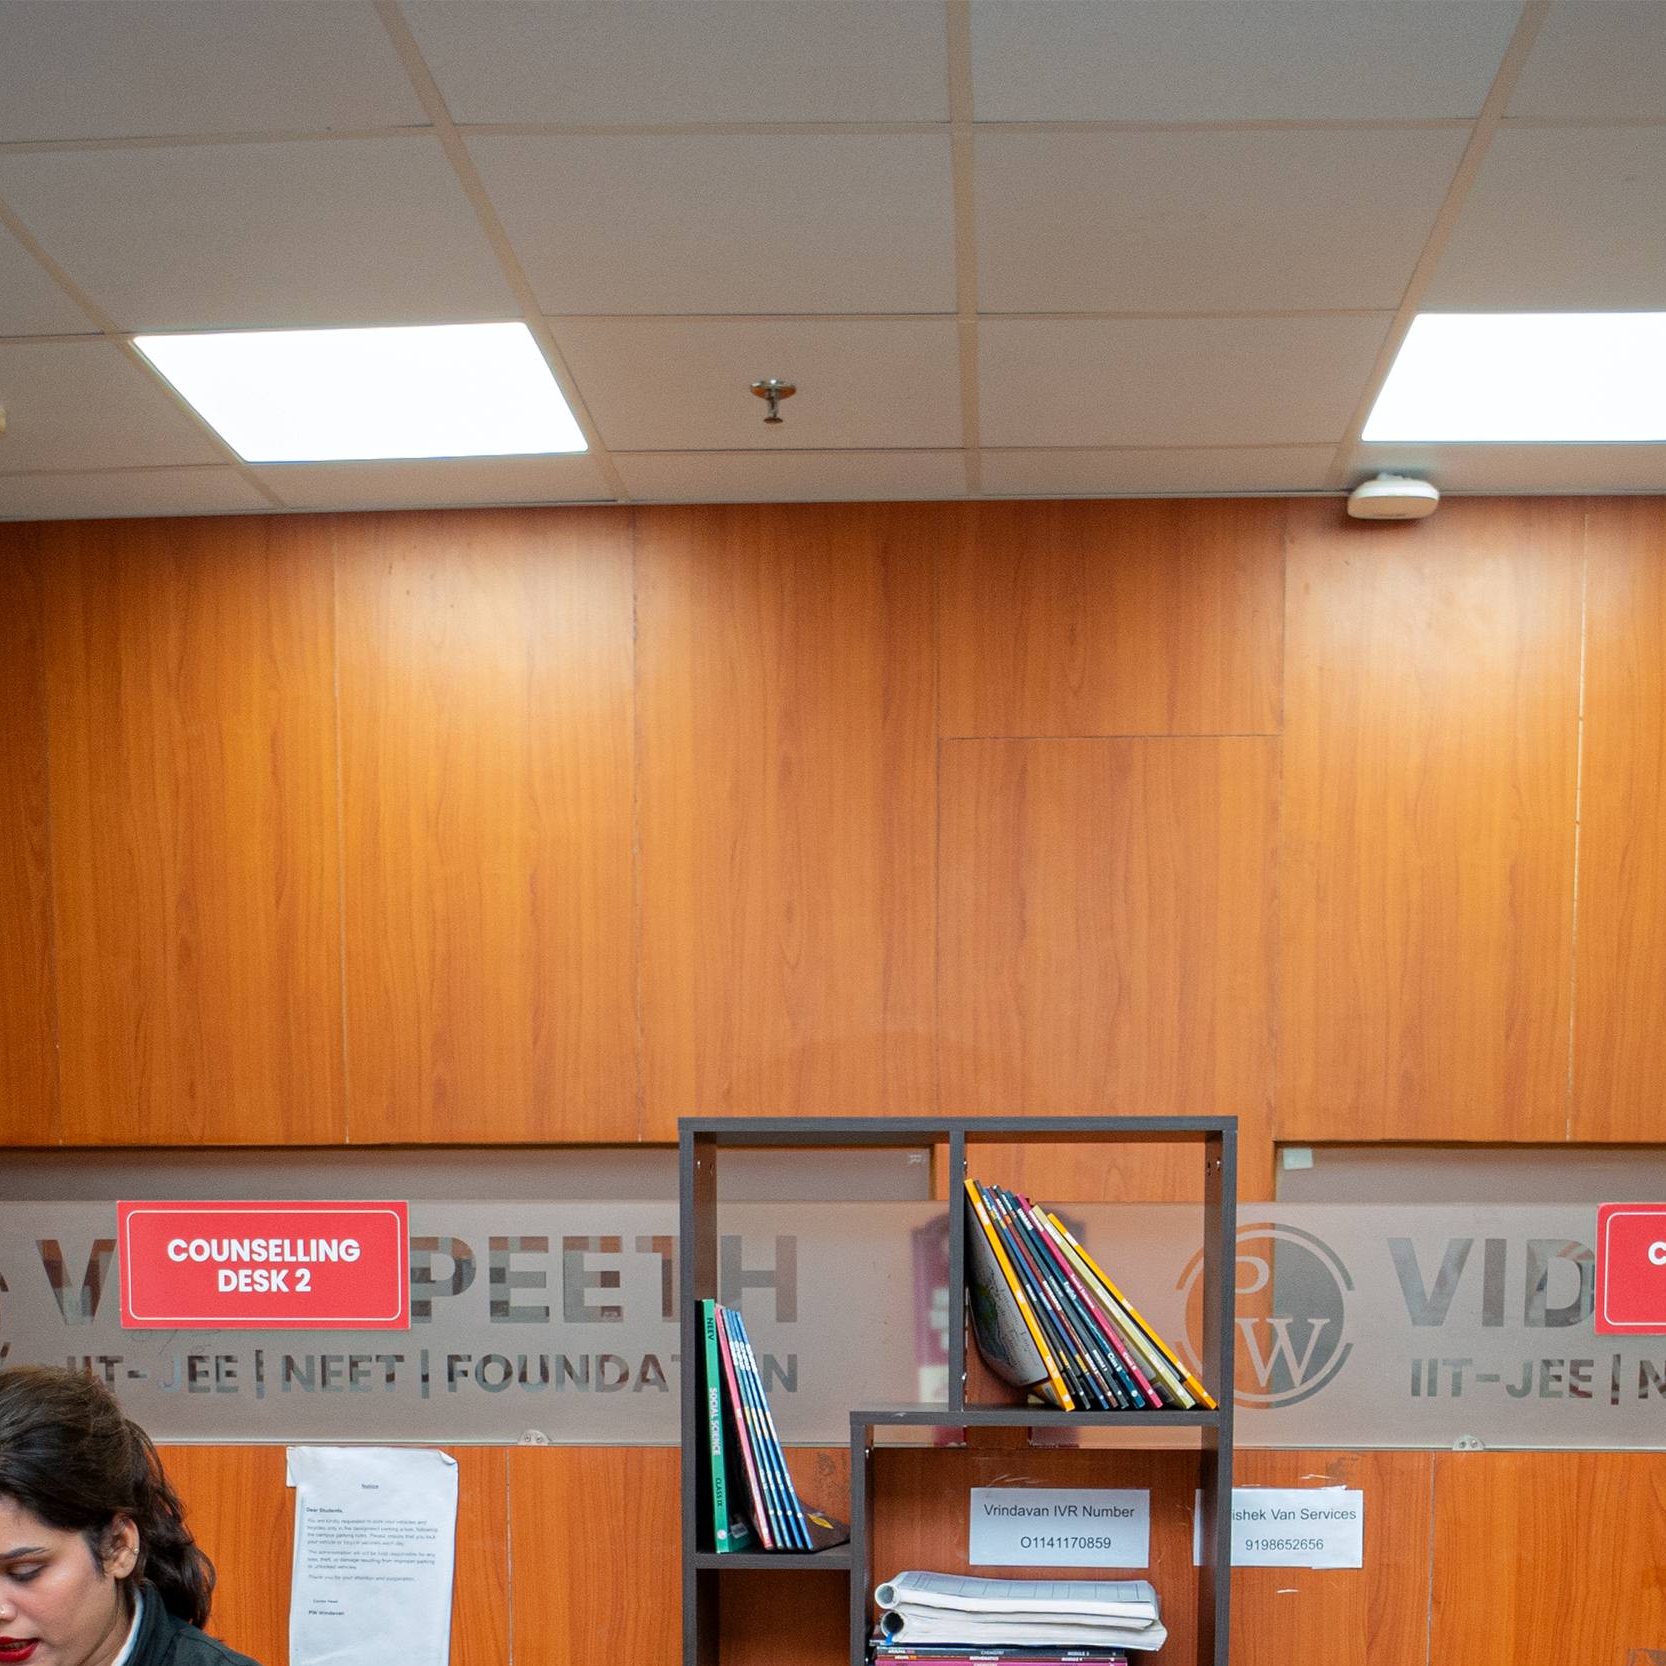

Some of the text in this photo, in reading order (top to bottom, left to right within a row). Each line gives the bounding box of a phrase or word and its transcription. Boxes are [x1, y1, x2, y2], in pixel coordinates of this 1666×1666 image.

[167, 1238, 361, 1263] COUNSELLING
[36, 1232, 797, 1328] VPEETH
[218, 1268, 312, 1293] DESK 2
[707, 1317, 715, 1341] NEEV
[285, 1354, 406, 1393] NEET
[446, 1352, 798, 1394] FOUNDAN
[709, 1387, 718, 1420] SOCIAL
[711, 1423, 721, 1456] SCIENCE
[983, 1503, 1135, 1518] Vrindavan IVR Number
[1271, 1508, 1297, 1521] Van
[1300, 1508, 1357, 1521] Services
[1244, 1537, 1325, 1551] 9198652656
